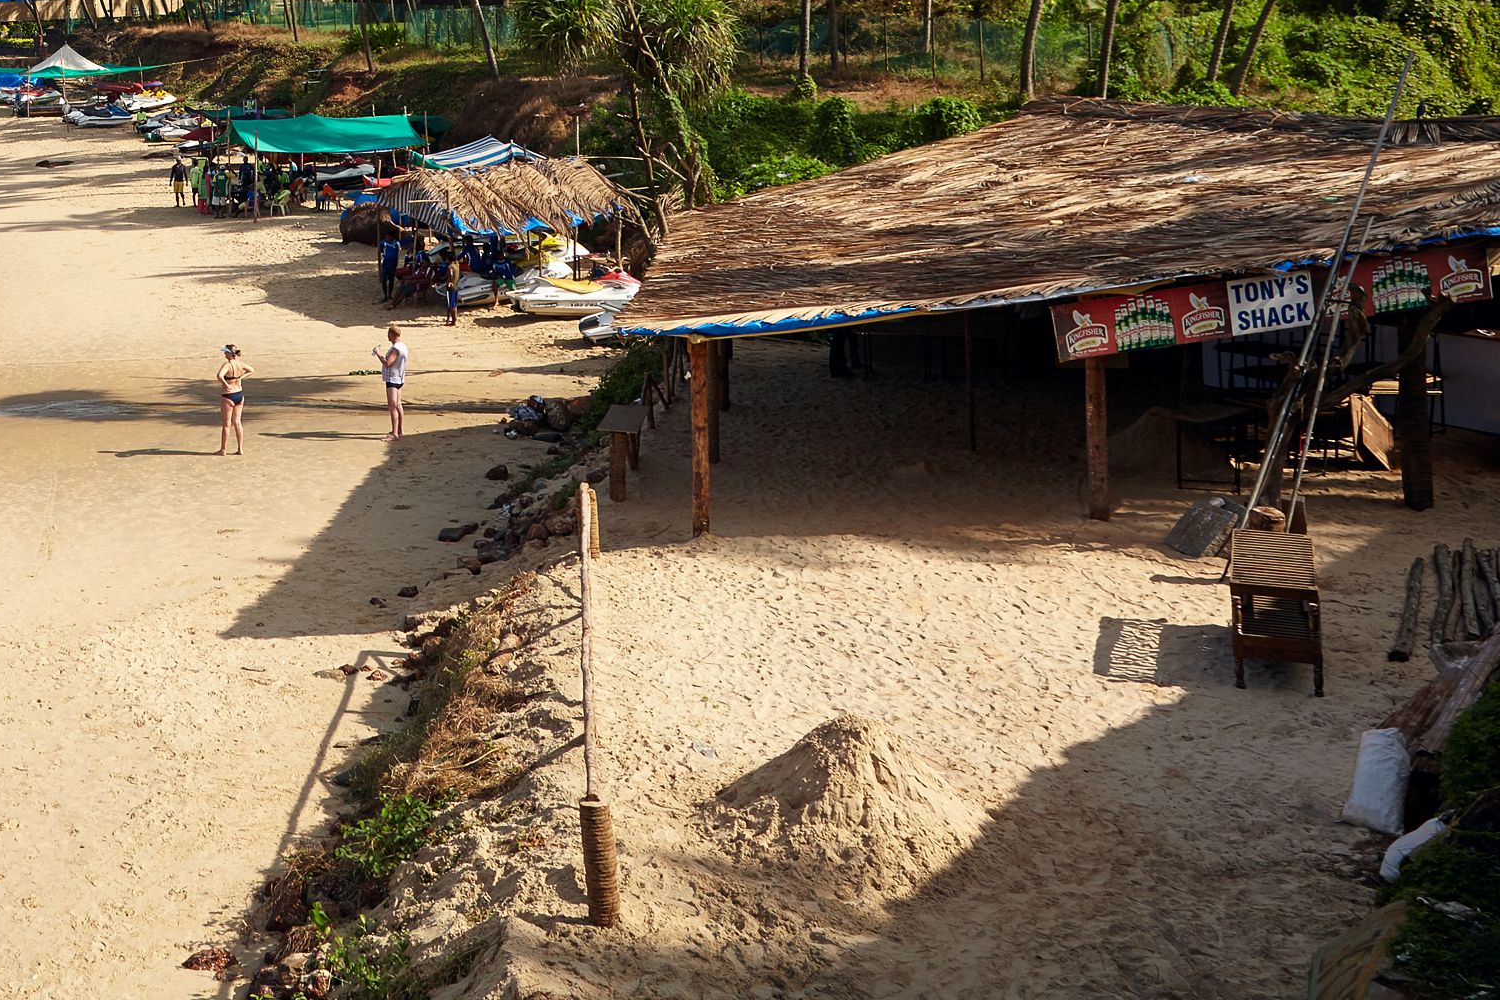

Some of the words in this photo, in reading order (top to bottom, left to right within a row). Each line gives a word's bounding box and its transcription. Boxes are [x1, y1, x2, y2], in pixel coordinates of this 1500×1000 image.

[1230, 274, 1309, 304] TONY'S
[1443, 273, 1480, 289] KINGFISHER
[1185, 310, 1221, 326] KINGFISHER
[1237, 301, 1311, 331] SHACK
[1068, 328, 1105, 345] KINGFISHER
